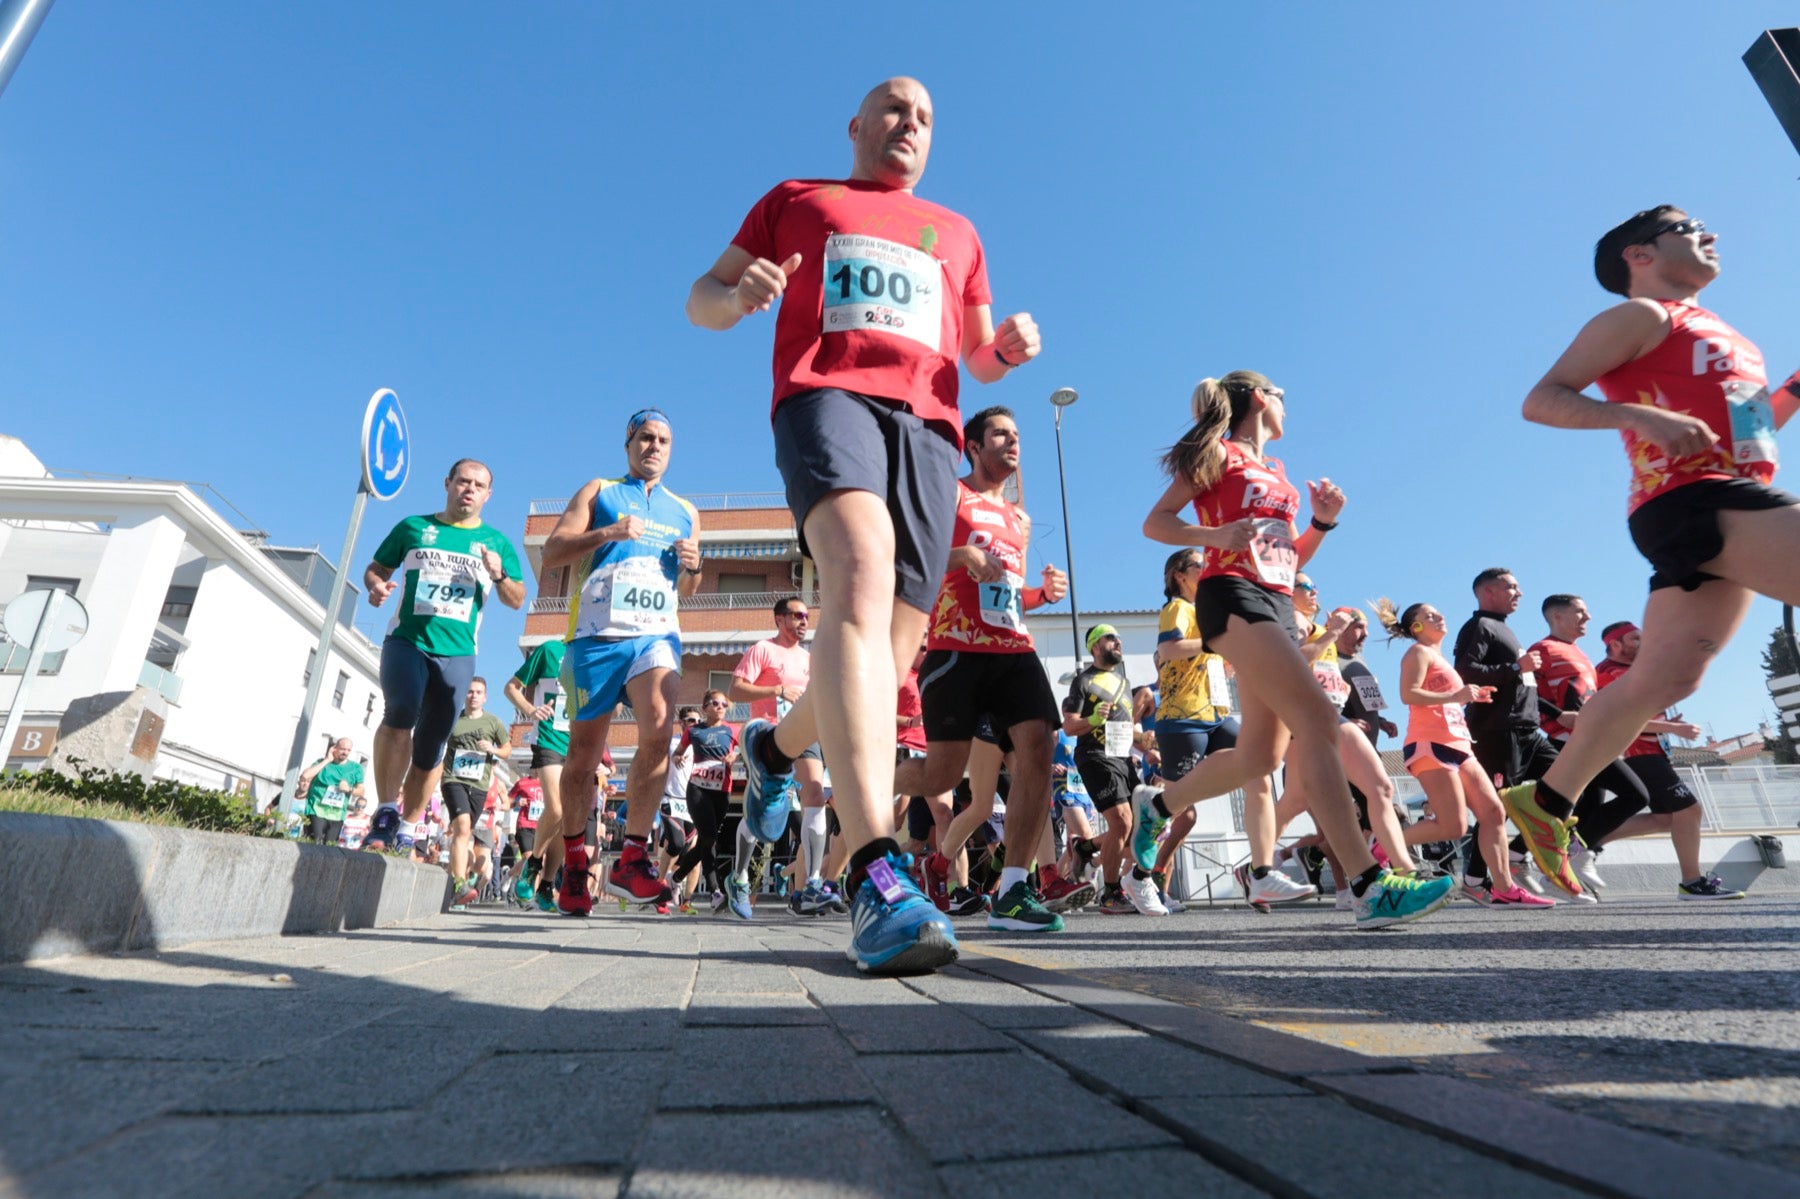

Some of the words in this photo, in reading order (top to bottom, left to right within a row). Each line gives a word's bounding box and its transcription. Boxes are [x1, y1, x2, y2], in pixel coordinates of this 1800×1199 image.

[833, 264, 911, 304] 100
[415, 551, 441, 561] CAJA
[447, 554, 481, 571] RURAL
[427, 584, 466, 604] 792
[624, 587, 665, 610] 460
[989, 586, 1019, 610] 72
[22, 732, 42, 751] B
